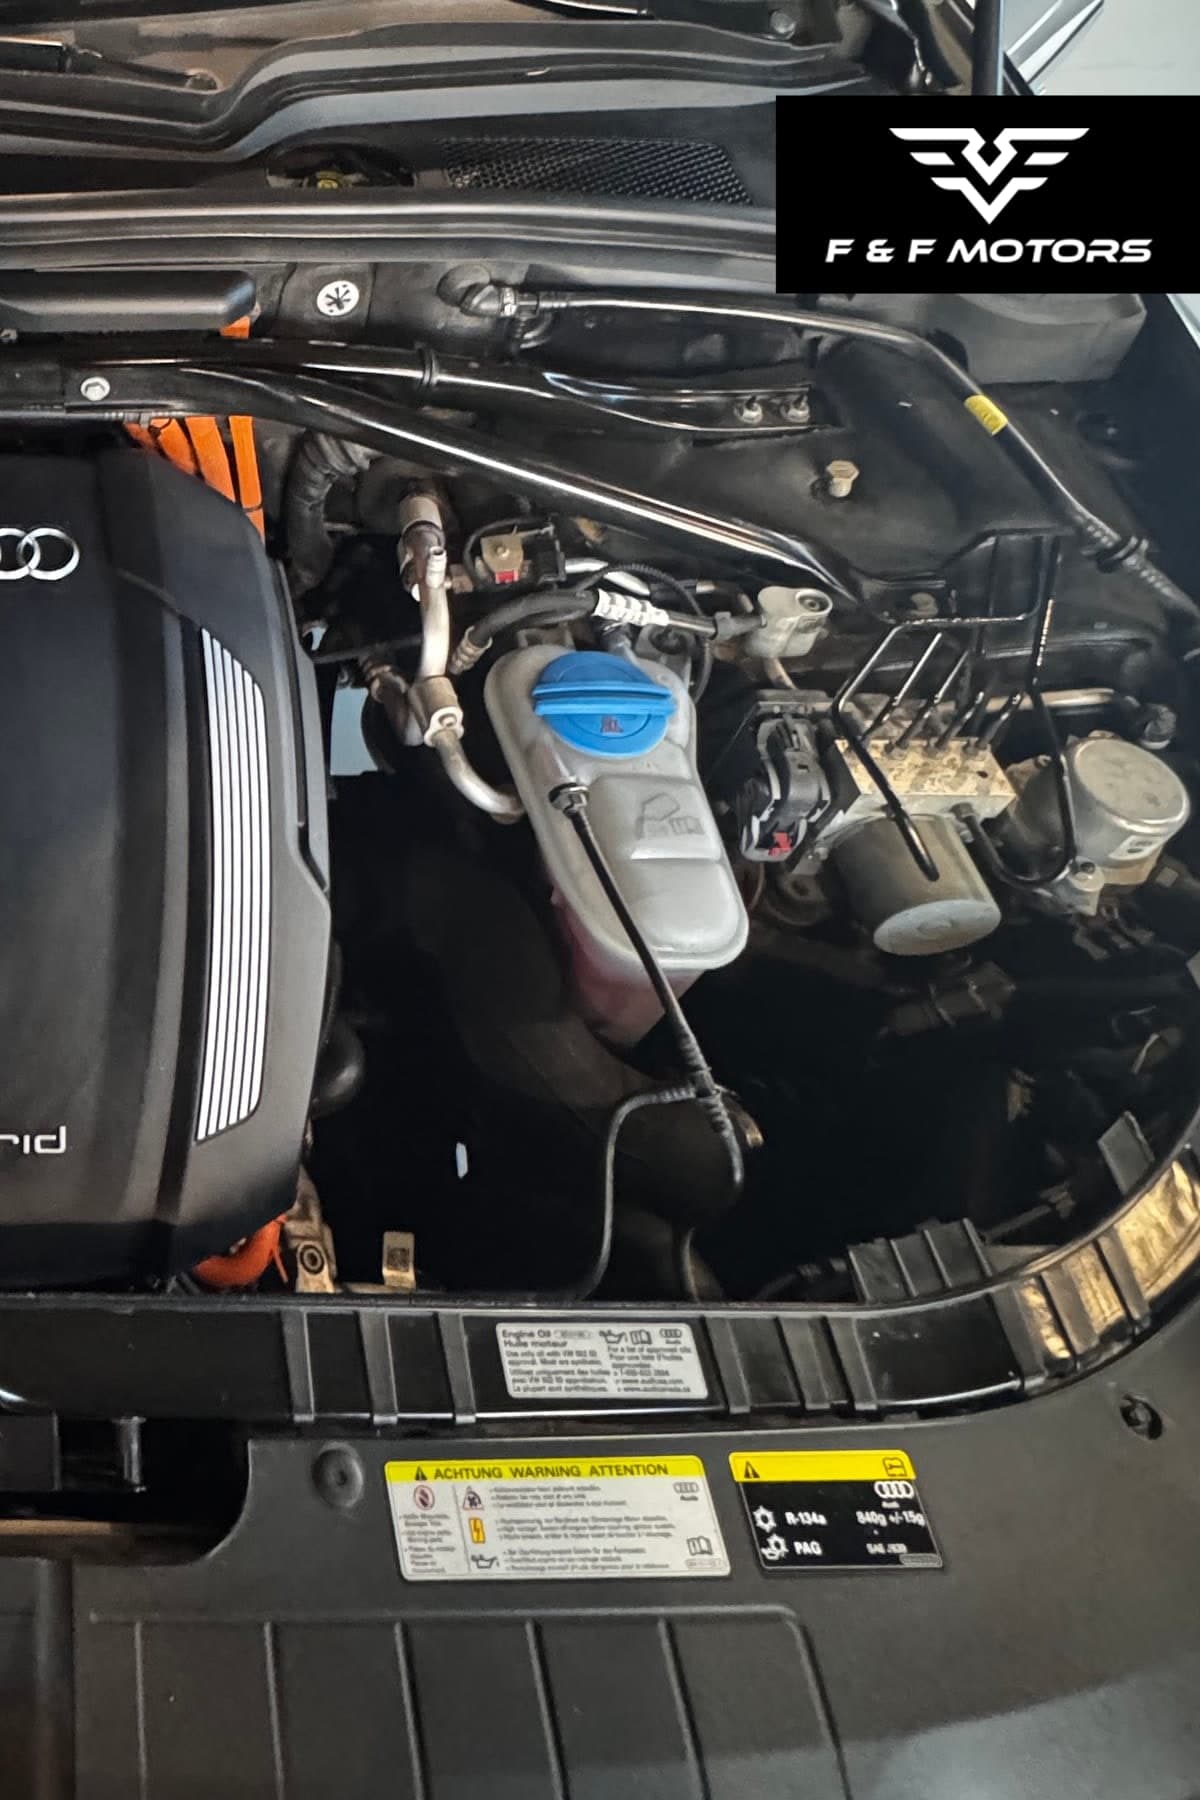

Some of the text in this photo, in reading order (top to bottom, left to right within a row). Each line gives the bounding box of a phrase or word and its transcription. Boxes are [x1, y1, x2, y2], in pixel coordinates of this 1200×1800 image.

[502, 1329, 535, 1341] Engine
[434, 1462, 669, 1479] ACHTUNG WARNING ATTENTION
[785, 1511, 827, 1526] R-134a
[793, 1541, 823, 1556] PAG
